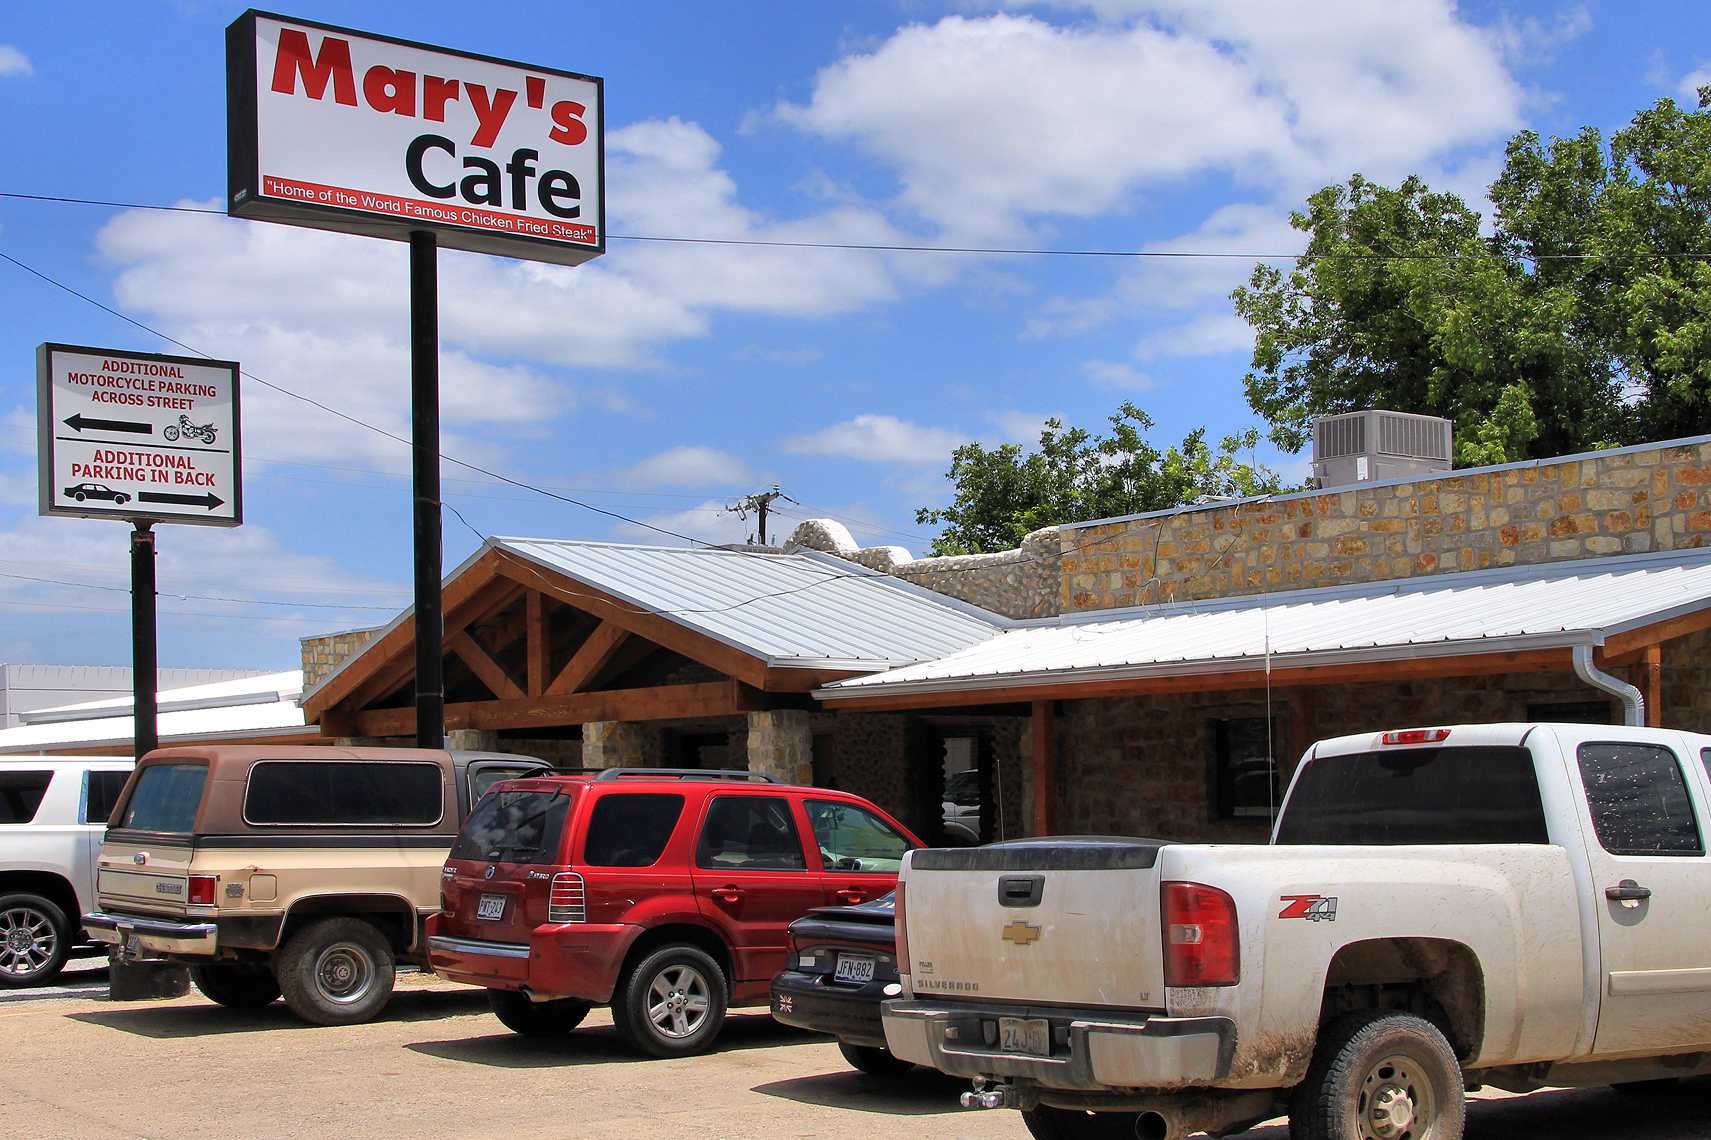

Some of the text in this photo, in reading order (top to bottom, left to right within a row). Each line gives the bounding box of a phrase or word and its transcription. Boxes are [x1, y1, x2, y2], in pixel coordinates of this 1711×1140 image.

[270, 28, 588, 149] Mary's
[405, 134, 581, 218] Cafe
[267, 180, 593, 240] "Home of the World Famous Chicken Fried Steak"
[102, 360, 184, 379] ADDITIONAL
[68, 372, 217, 398] MOTORCYCLE PARKING
[91, 391, 195, 411] ACROSS STREET
[93, 449, 196, 470] ADDITIONAL
[72, 463, 216, 487] PARKING IN BACK
[917, 979, 979, 992] SILVERADO
